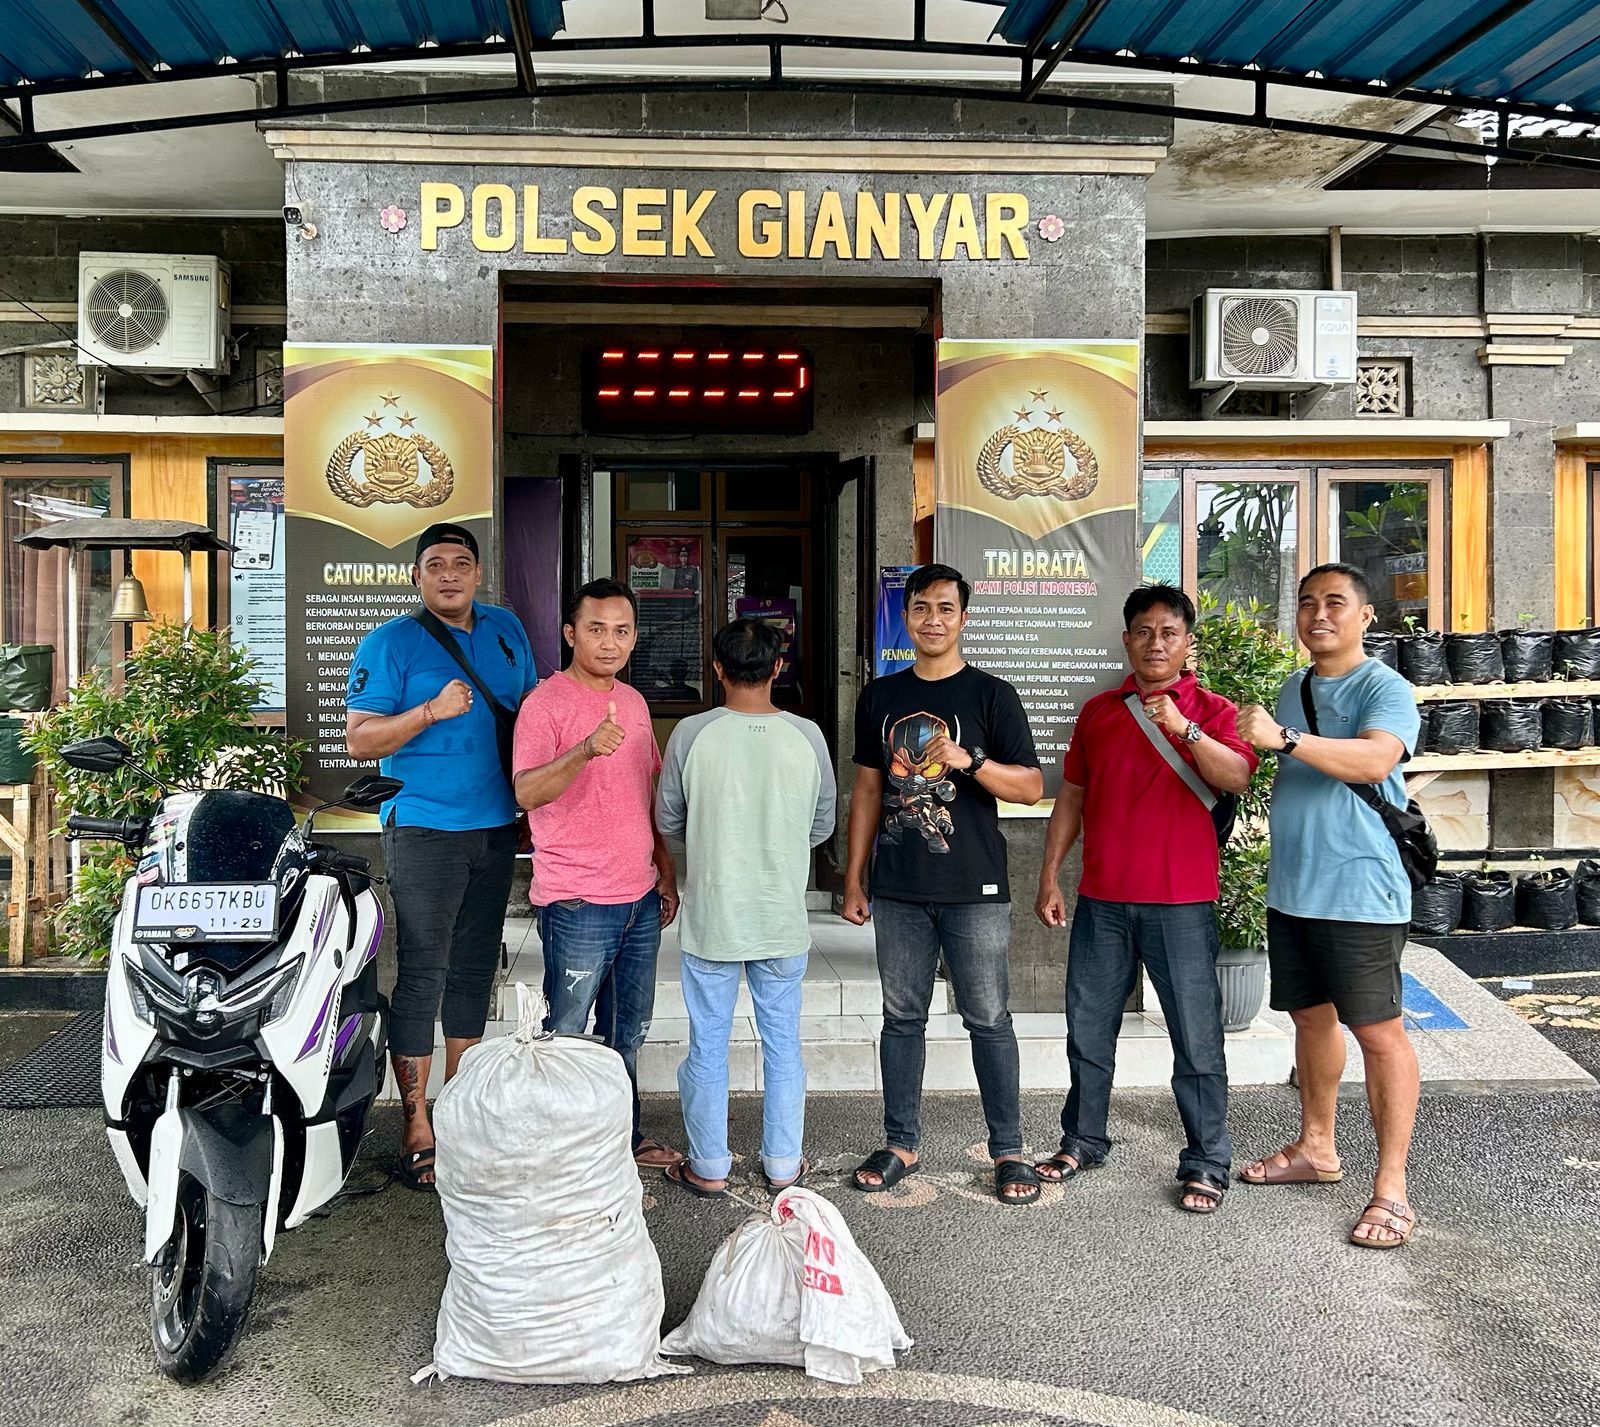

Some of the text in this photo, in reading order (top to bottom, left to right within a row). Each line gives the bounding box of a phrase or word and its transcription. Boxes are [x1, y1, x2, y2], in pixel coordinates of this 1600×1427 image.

[420, 182, 1030, 261] POLSEK GIANYAR
[173, 274, 210, 282] SAMSUNG
[1319, 322, 1349, 332] AQUA
[983, 549, 1090, 579] TRI BRATA
[323, 562, 375, 586] CATUR
[974, 580, 1098, 597] KAMI POLISI INDONESIA
[305, 594, 423, 603] SEBAGAI INSAN BHAYANGKARA
[305, 608, 358, 617] KEHORMATAN
[359, 608, 379, 617] SAYA
[966, 606, 1087, 615] ERBAKTI KEPADA NUSA DAN BANGSA
[305, 621, 354, 631] BERKORBAN
[355, 621, 374, 631] DEMI
[991, 619, 1014, 628] PENUH
[1014, 620, 1056, 628] KETAQWAAN
[1057, 620, 1093, 629] TERHADAP
[305, 636, 322, 645] DAN
[323, 636, 356, 645] NEGARA
[962, 633, 1039, 642] TUHAN YANG MAHA ESA
[962, 646, 1108, 657] MENJUNJUNG TINGGI KEBENARAN, KEADILAN
[306, 652, 314, 661] 1.
[977, 660, 1025, 669] KEMANUSIAAN
[1025, 661, 1049, 669] DALAM
[1051, 661, 1098, 670] MENEGAKKAN
[1099, 662, 1123, 670] HUKUM
[318, 667, 350, 677] GANGG
[352, 667, 370, 693] 3
[1026, 674, 1059, 683] REPUBLIK
[1059, 675, 1096, 684] INDONESIA
[306, 683, 314, 692] 2.
[1031, 688, 1069, 697] PANCASILA
[318, 698, 347, 707] HARTA
[1035, 702, 1059, 710] DASAR
[1059, 702, 1075, 711] 1945
[306, 713, 347, 722] 3. MENJA
[319, 744, 348, 753] MEMEL
[319, 759, 357, 768] TENTRAM
[143, 930, 171, 938] YAMAHA
